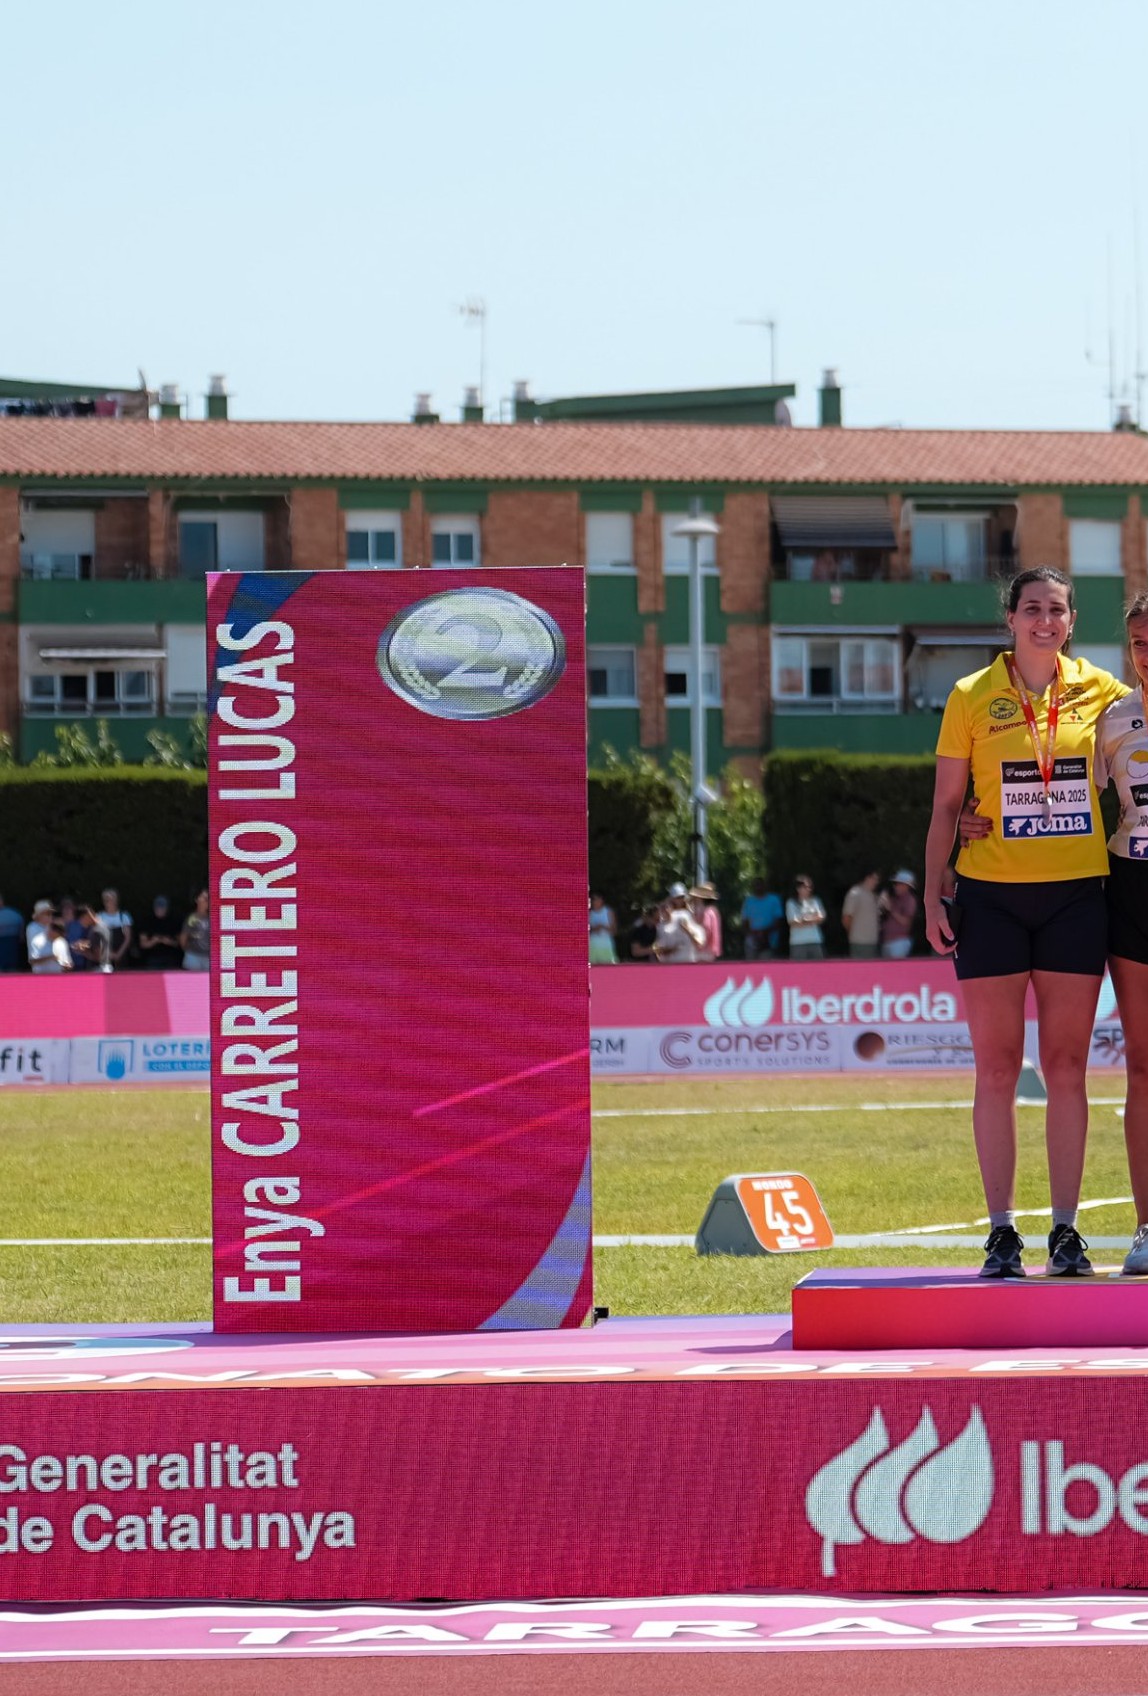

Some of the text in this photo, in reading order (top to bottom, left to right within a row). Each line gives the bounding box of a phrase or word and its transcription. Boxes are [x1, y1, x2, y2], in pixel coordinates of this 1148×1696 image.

[1005, 789, 1087, 805] TARRAGNA 2025
[216, 620, 325, 1302] Enya CARRETERO LUCAS
[780, 983, 957, 1024] Iberdrola
[763, 1191, 815, 1237] 45
[673, 1361, 934, 1375] DE
[0, 1442, 299, 1493] Generalitat
[0, 1502, 356, 1562] de Catalunya
